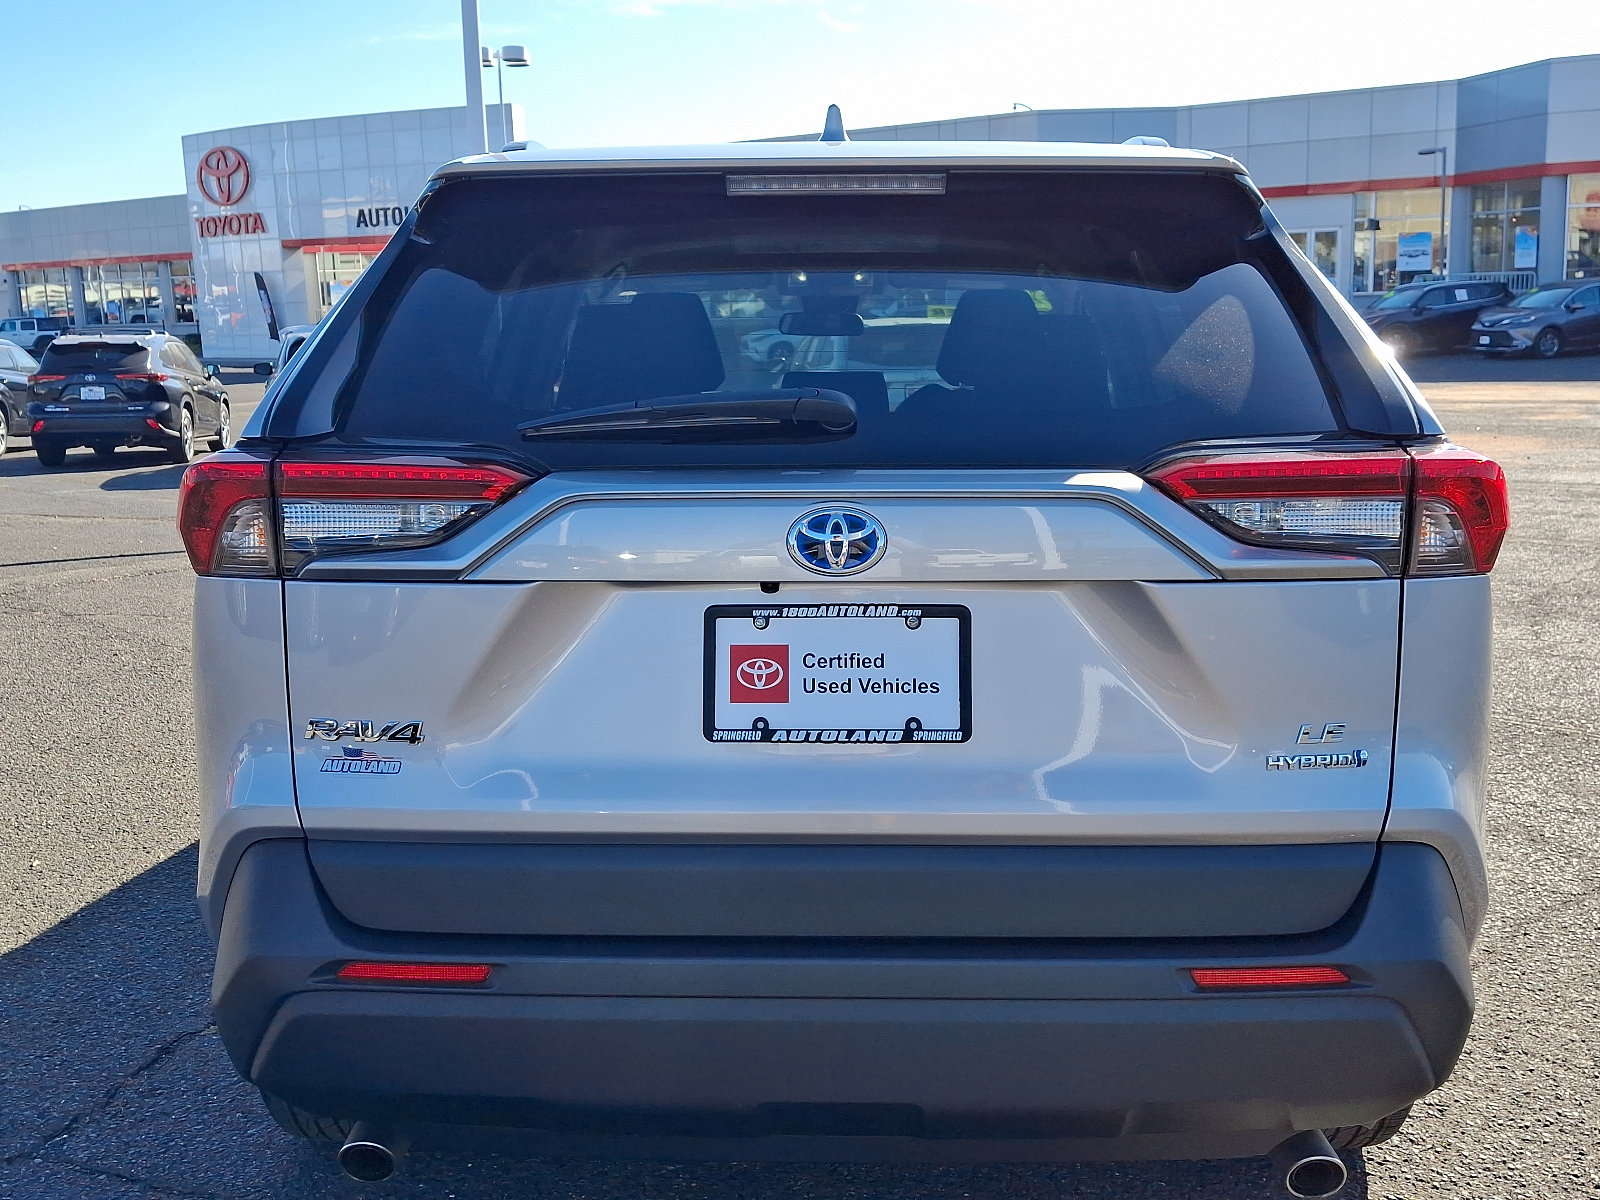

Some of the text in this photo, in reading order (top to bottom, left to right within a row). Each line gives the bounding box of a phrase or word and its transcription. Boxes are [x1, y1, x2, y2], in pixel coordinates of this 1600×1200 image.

[197, 212, 267, 238] TOYOTA
[802, 652, 885, 670] Certified
[802, 677, 941, 694] Used Vehicles
[303, 717, 426, 745] RAV4
[712, 729, 963, 742] SPRINGFIELD AUTOLAND SPRINGFIELD
[1295, 721, 1347, 744] LE
[321, 759, 401, 774] AUTOLAND
[1265, 752, 1356, 771] HYBRID
